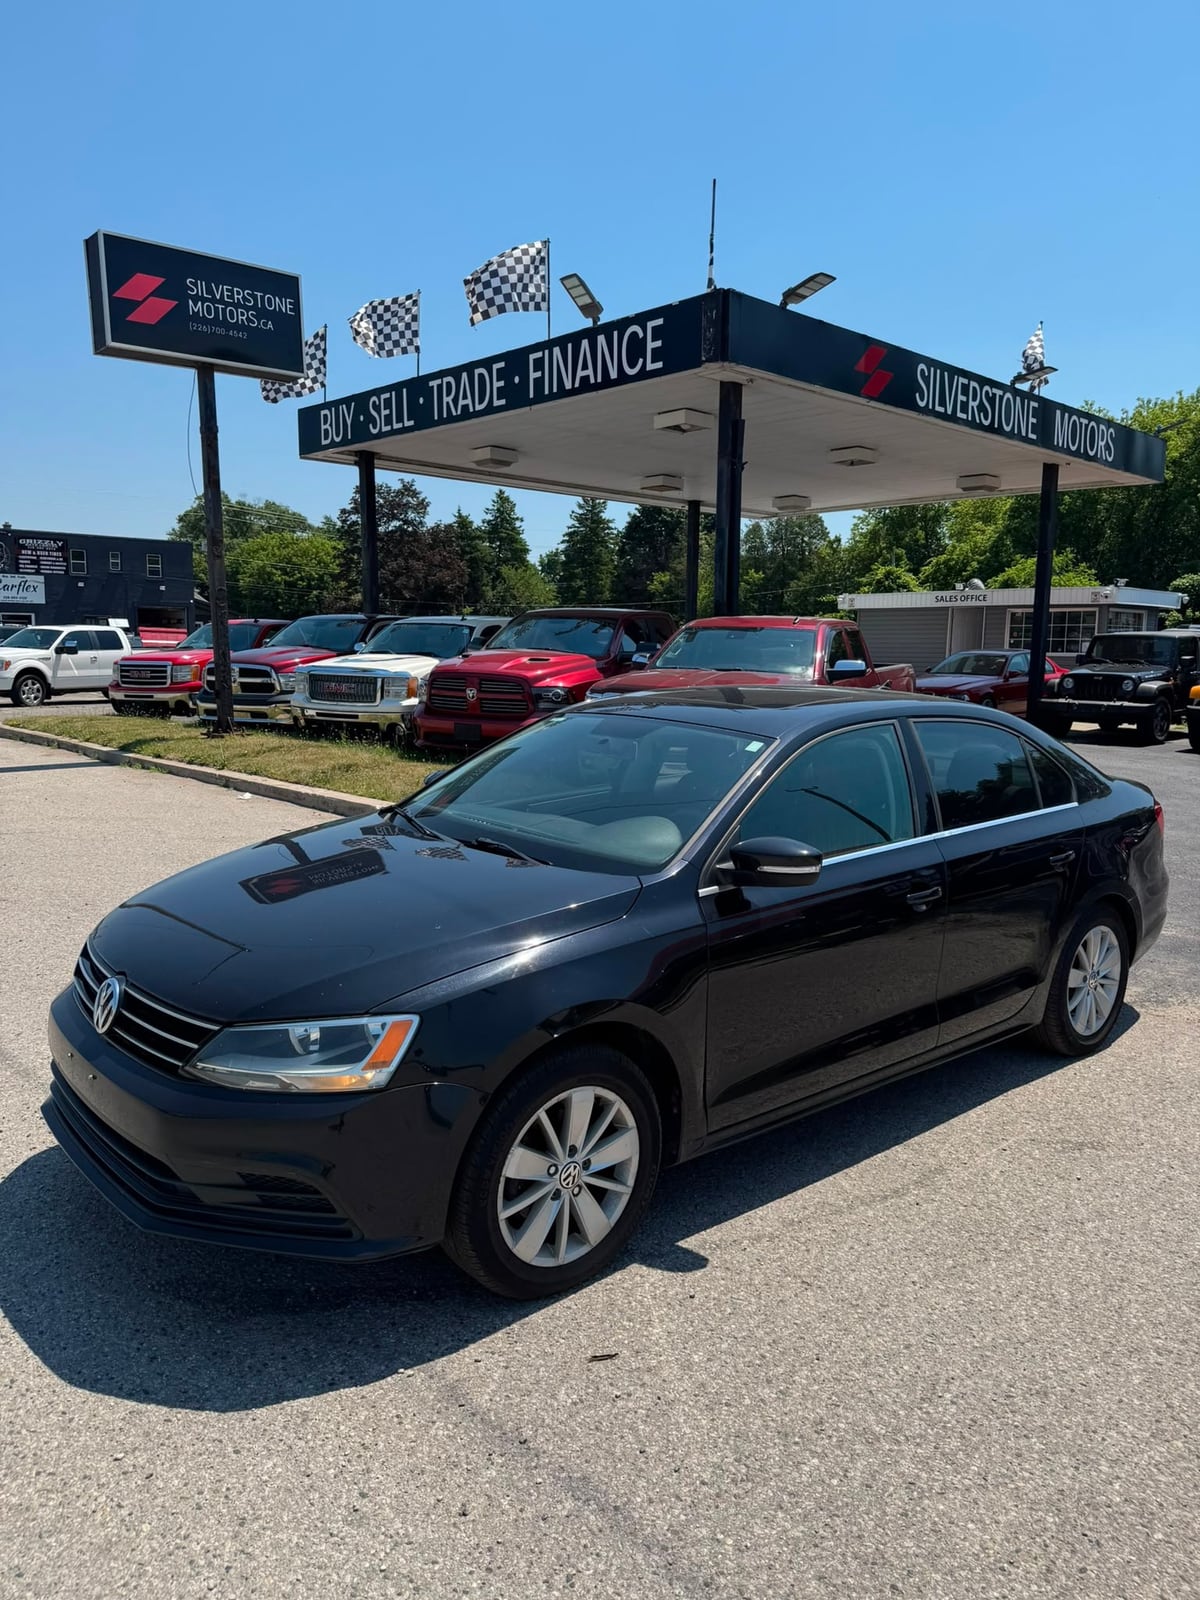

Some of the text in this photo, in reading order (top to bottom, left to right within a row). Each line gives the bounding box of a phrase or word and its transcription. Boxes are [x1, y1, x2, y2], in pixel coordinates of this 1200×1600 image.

[186, 278, 295, 315] SILVERSTONE
[189, 322, 248, 339] (226)700-4542
[320, 317, 664, 446] BUY SELL TRADE FINANCE
[915, 362, 1115, 462] SILVERSTONE MOTORS
[19, 539, 63, 547] GRIZZLY
[935, 594, 988, 603] SALES OFFICE
